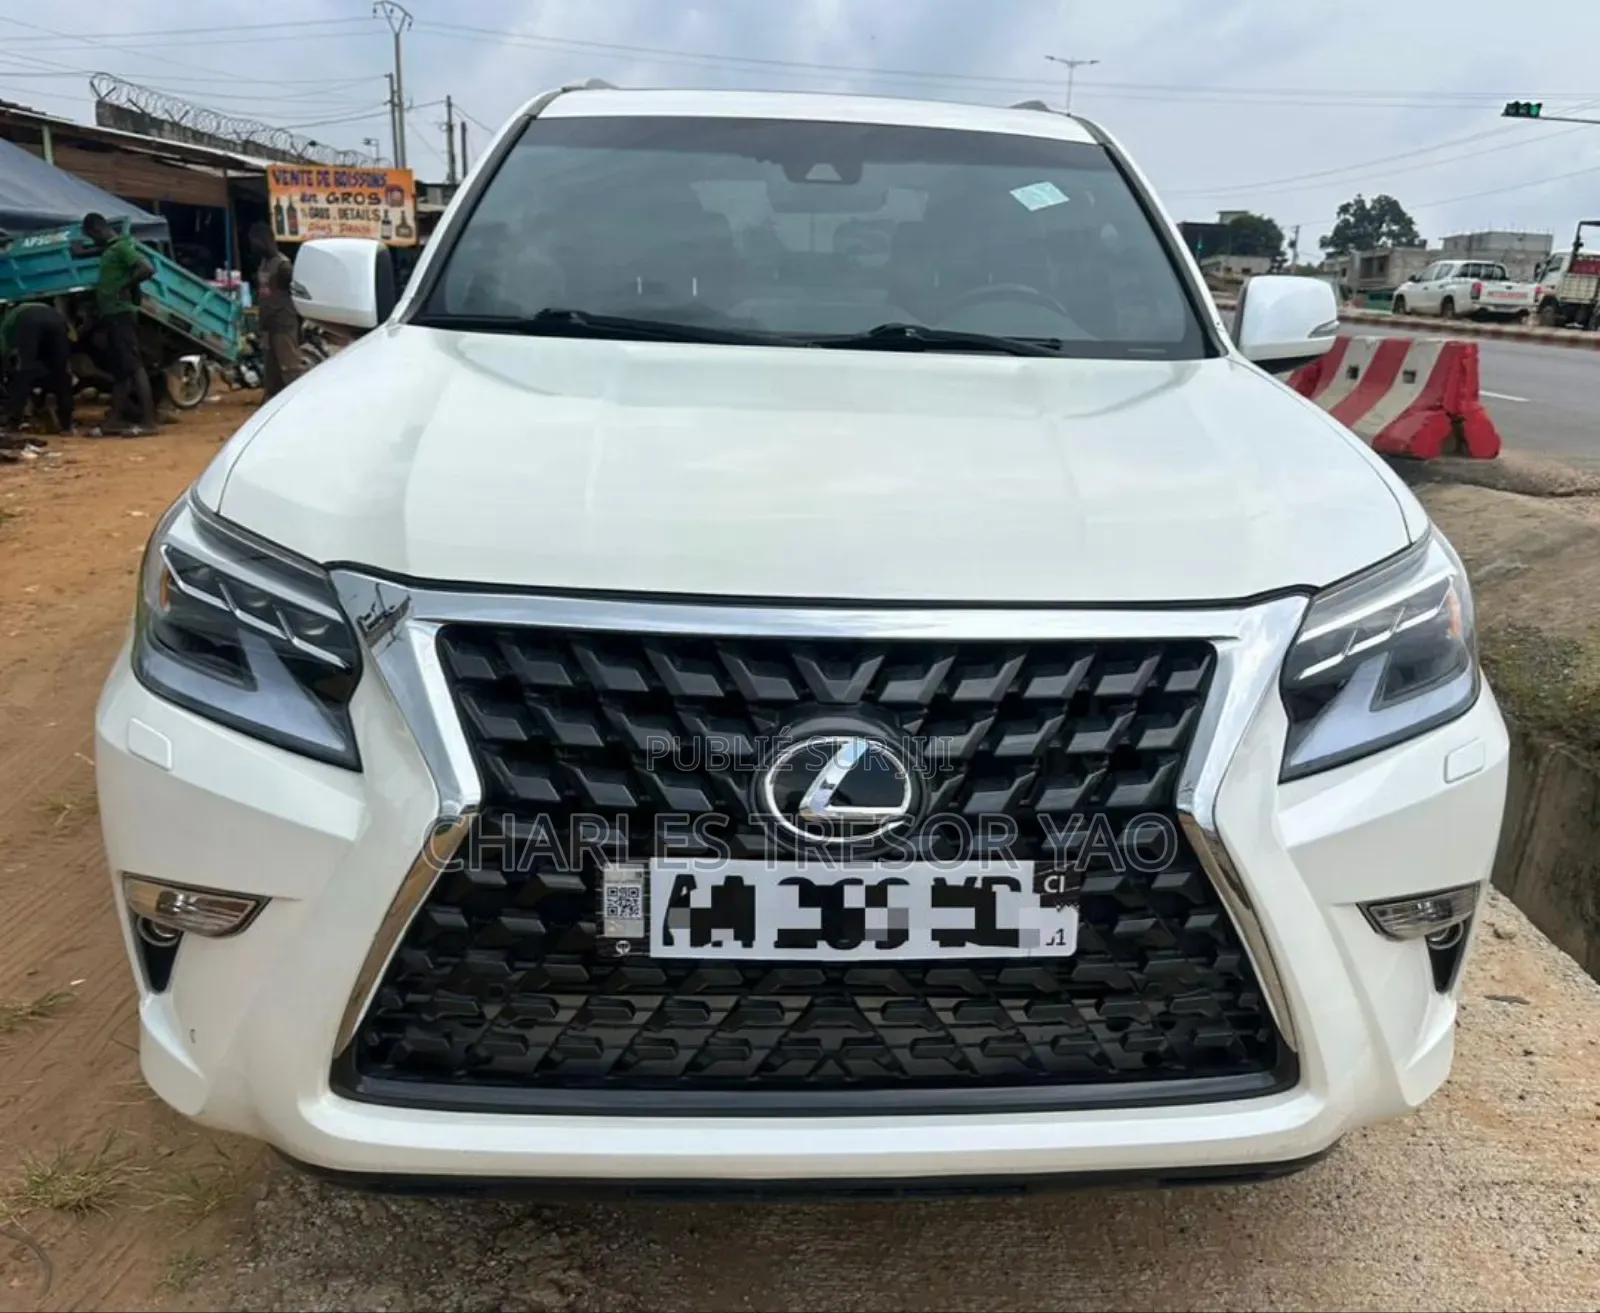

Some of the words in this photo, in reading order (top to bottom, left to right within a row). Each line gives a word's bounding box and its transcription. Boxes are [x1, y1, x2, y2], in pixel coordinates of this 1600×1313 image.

[271, 169, 313, 187] VENTE
[316, 169, 331, 187] DE
[333, 171, 387, 188] BOISSONS
[325, 191, 382, 206] GROS
